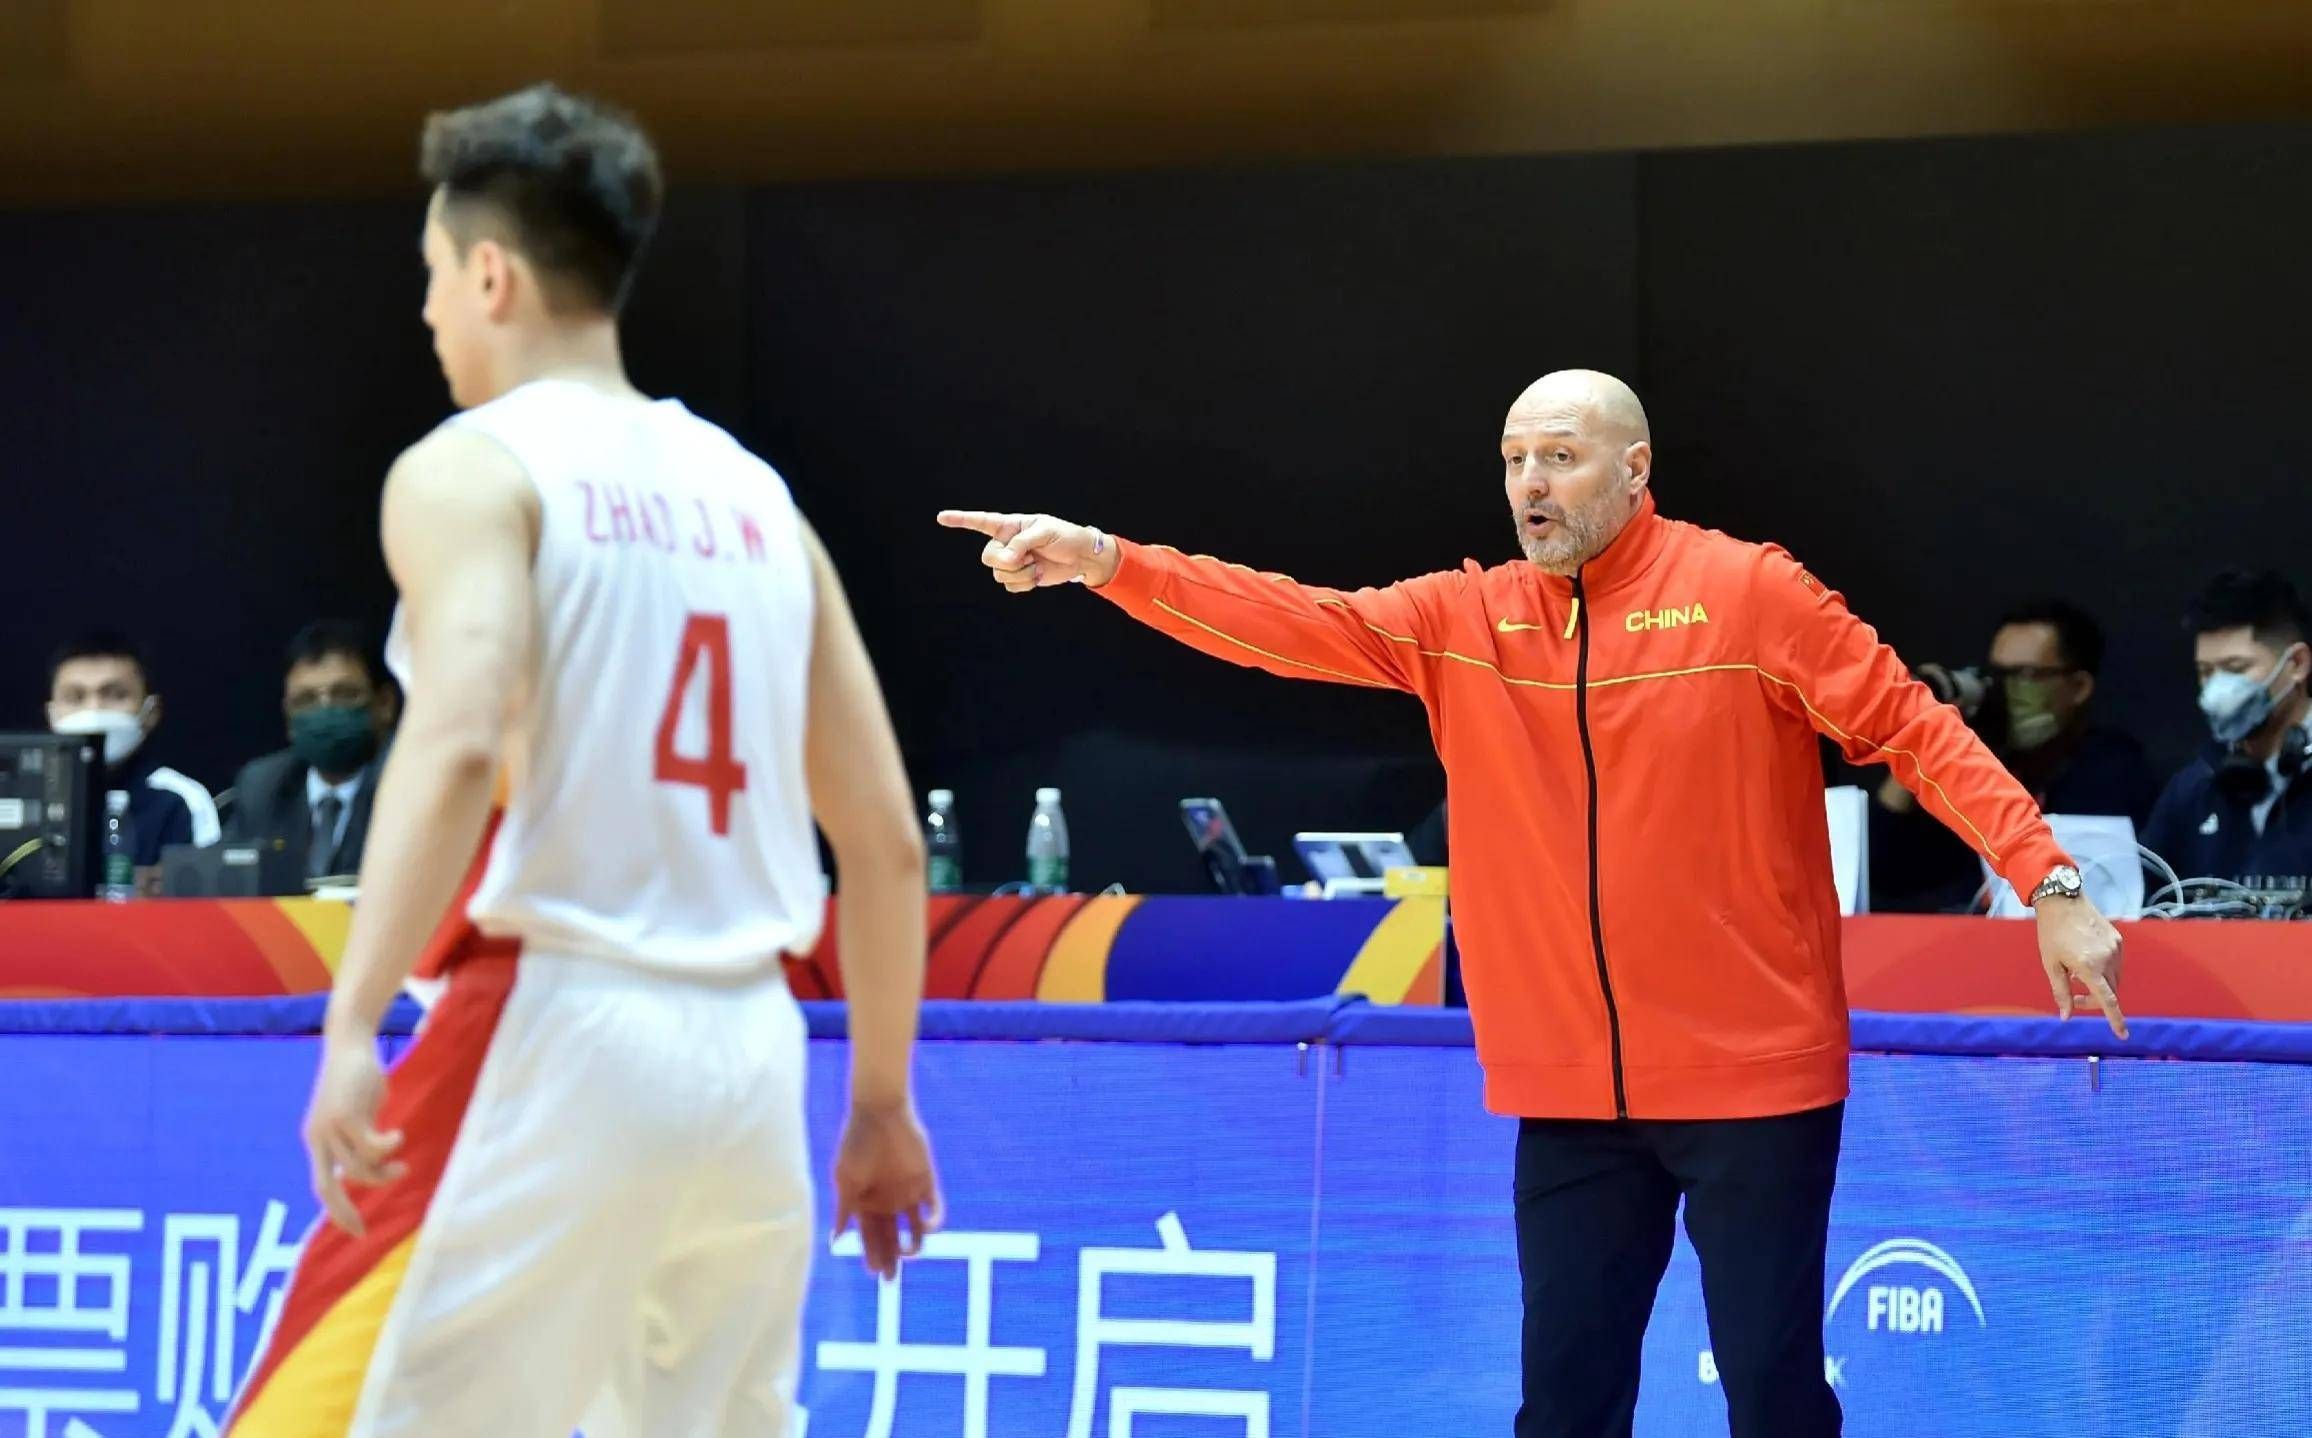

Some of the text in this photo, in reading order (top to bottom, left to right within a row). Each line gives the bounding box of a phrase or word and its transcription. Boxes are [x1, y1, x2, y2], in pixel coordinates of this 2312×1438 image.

[1625, 602, 1709, 633] CHINA
[653, 610, 747, 838] 4
[1867, 1285, 1945, 1333] FIBA
